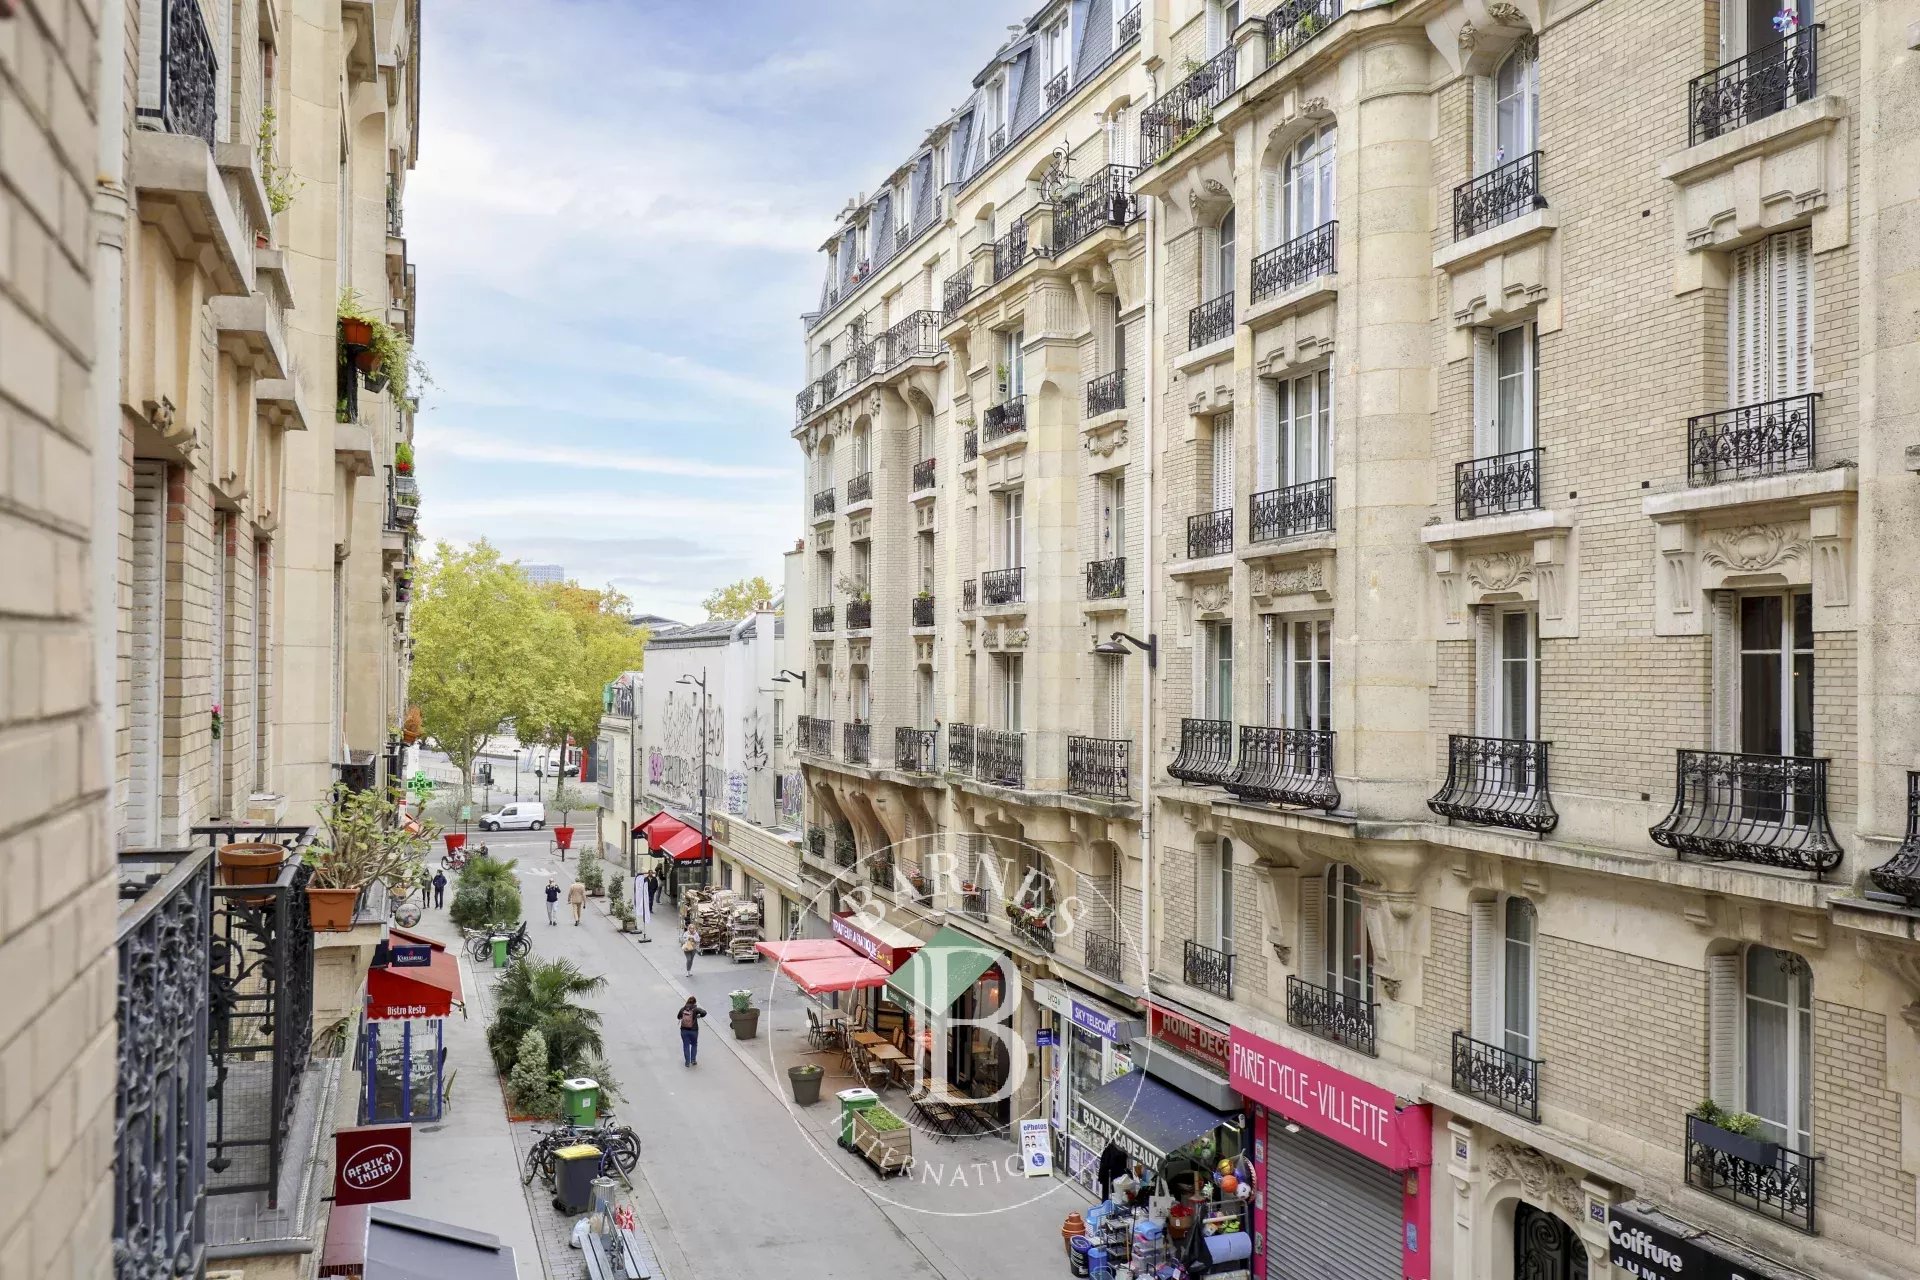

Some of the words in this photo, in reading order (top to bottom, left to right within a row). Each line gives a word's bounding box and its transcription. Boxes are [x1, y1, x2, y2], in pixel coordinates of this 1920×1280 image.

[387, 1005, 407, 1016] Bistro
[408, 1004, 427, 1015] Resto
[1074, 1006, 1086, 1024] SKY
[1085, 1012, 1112, 1038] TELECOM
[1162, 1013, 1198, 1044] HOME
[1233, 1042, 1265, 1088] PARIS
[1082, 1108, 1113, 1139] BAZAR
[1112, 1129, 1160, 1174] CADEAUX
[357, 1163, 393, 1185] INDIA
[1591, 1205, 1604, 1220] 22
[1608, 1220, 1683, 1272] Coiffure
